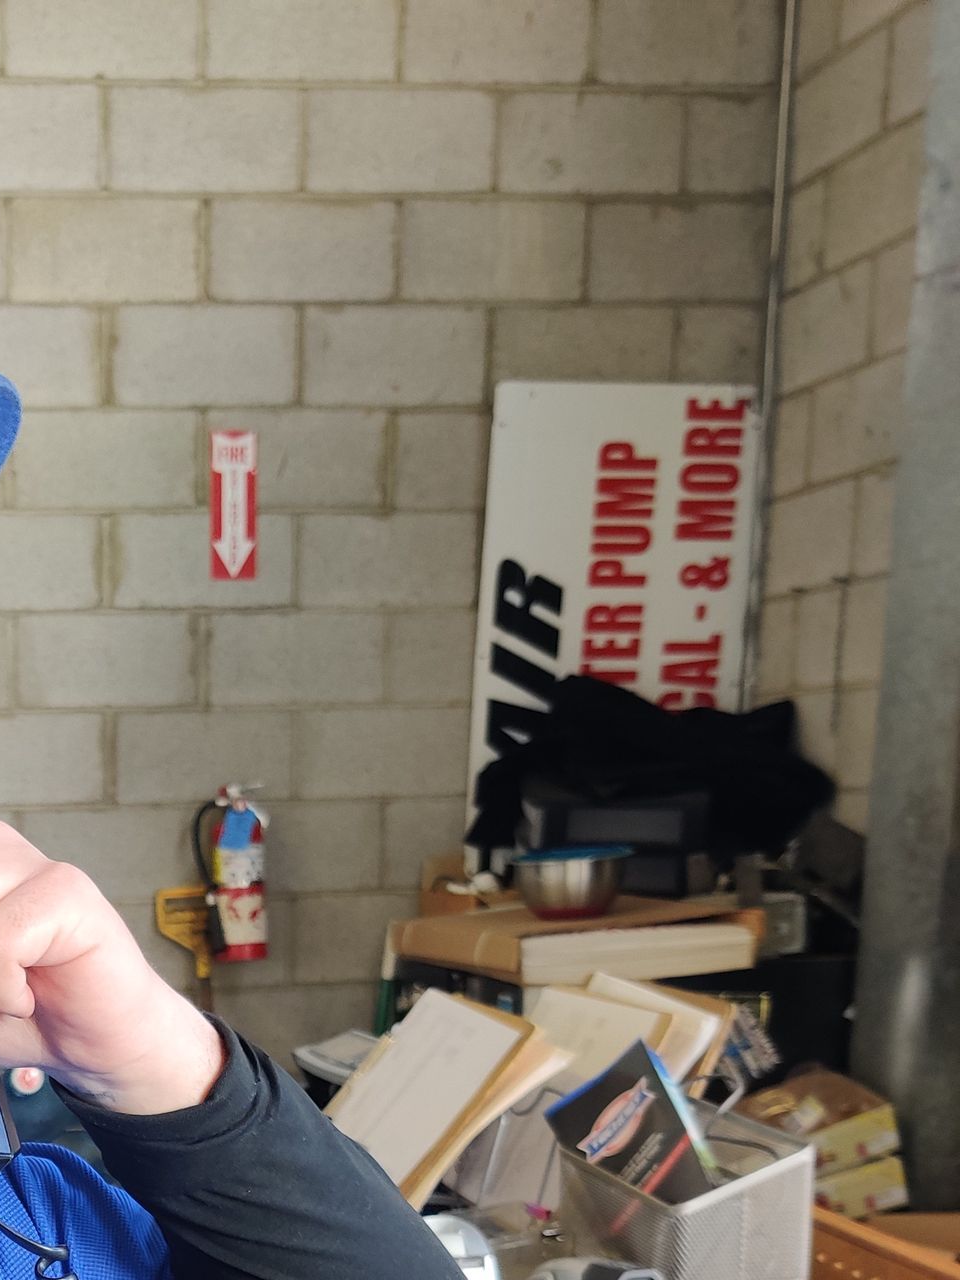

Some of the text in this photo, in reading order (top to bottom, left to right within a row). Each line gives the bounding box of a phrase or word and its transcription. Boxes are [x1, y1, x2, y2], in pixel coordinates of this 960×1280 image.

[587, 441, 657, 588] PUMP
[674, 396, 748, 541] MORE
[678, 557, 730, 592] &
[485, 558, 563, 766] AIR
